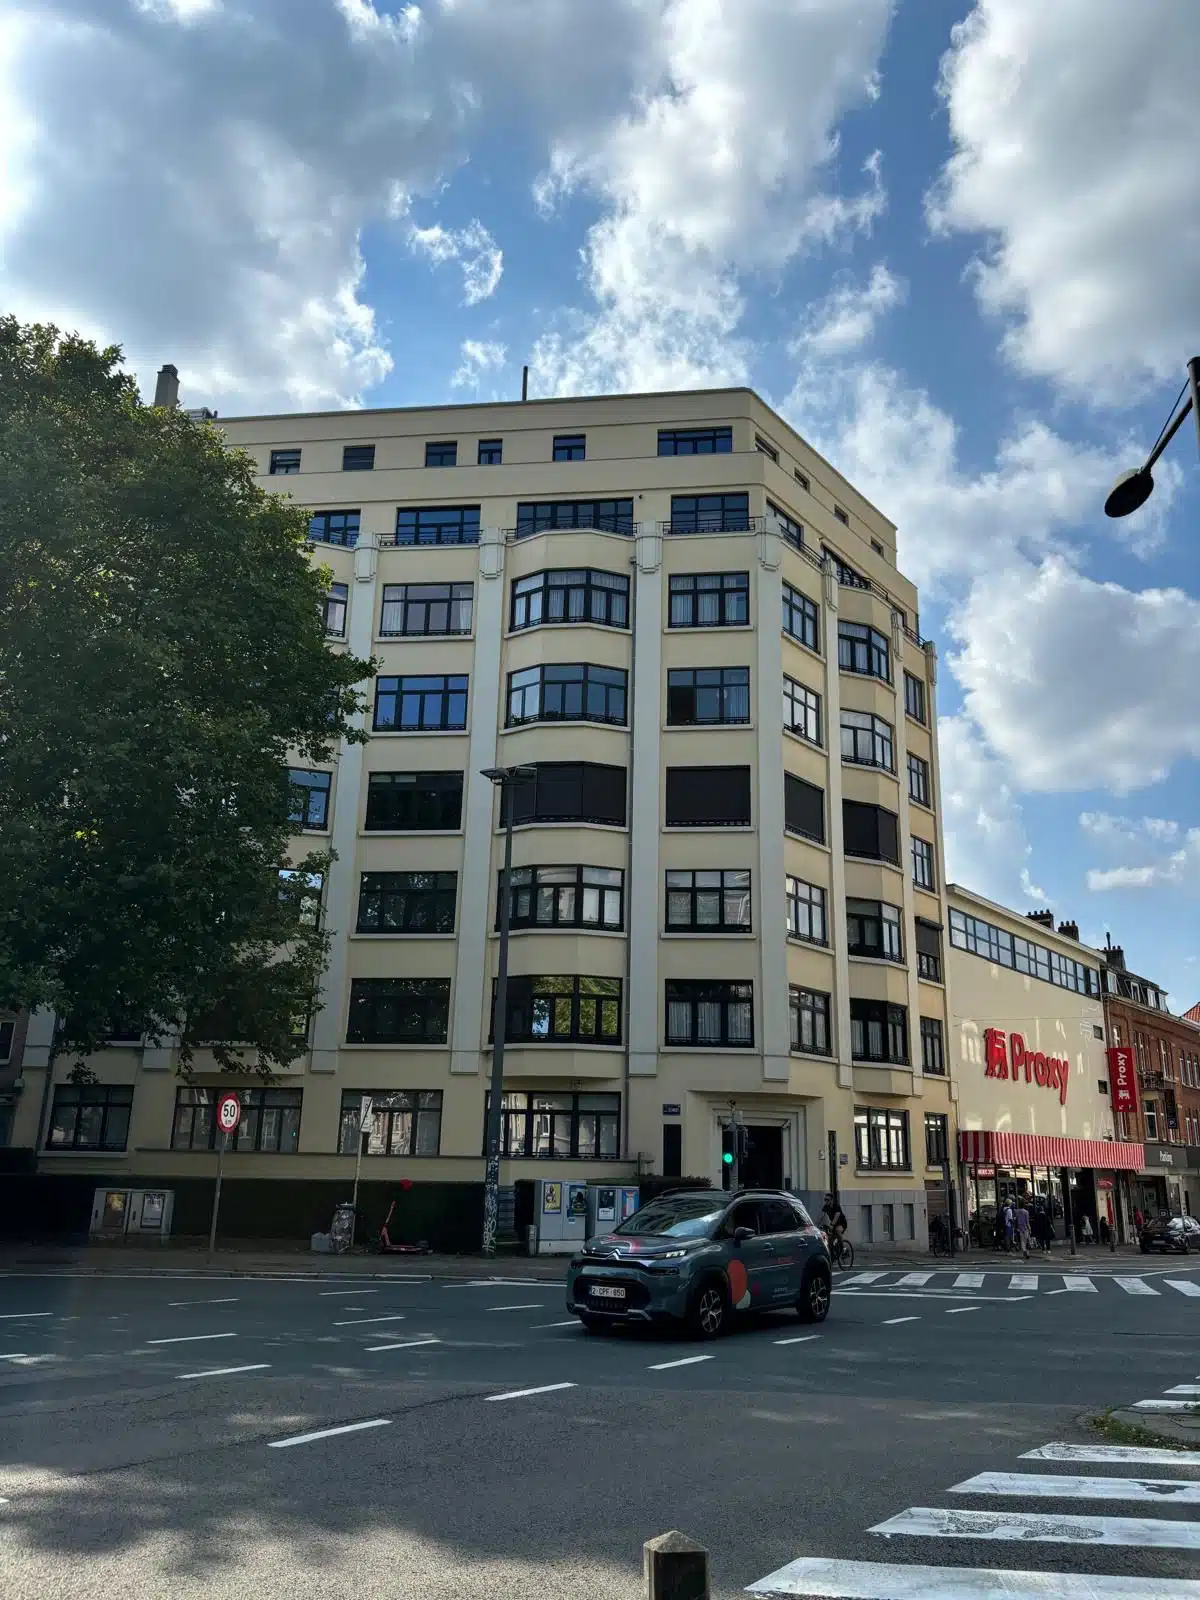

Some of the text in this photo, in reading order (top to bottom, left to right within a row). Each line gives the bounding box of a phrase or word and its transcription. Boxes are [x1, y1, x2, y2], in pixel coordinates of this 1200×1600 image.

[1010, 1033, 1068, 1105] Proxy
[1117, 1052, 1128, 1085] Proxy
[223, 1104, 236, 1118] 50
